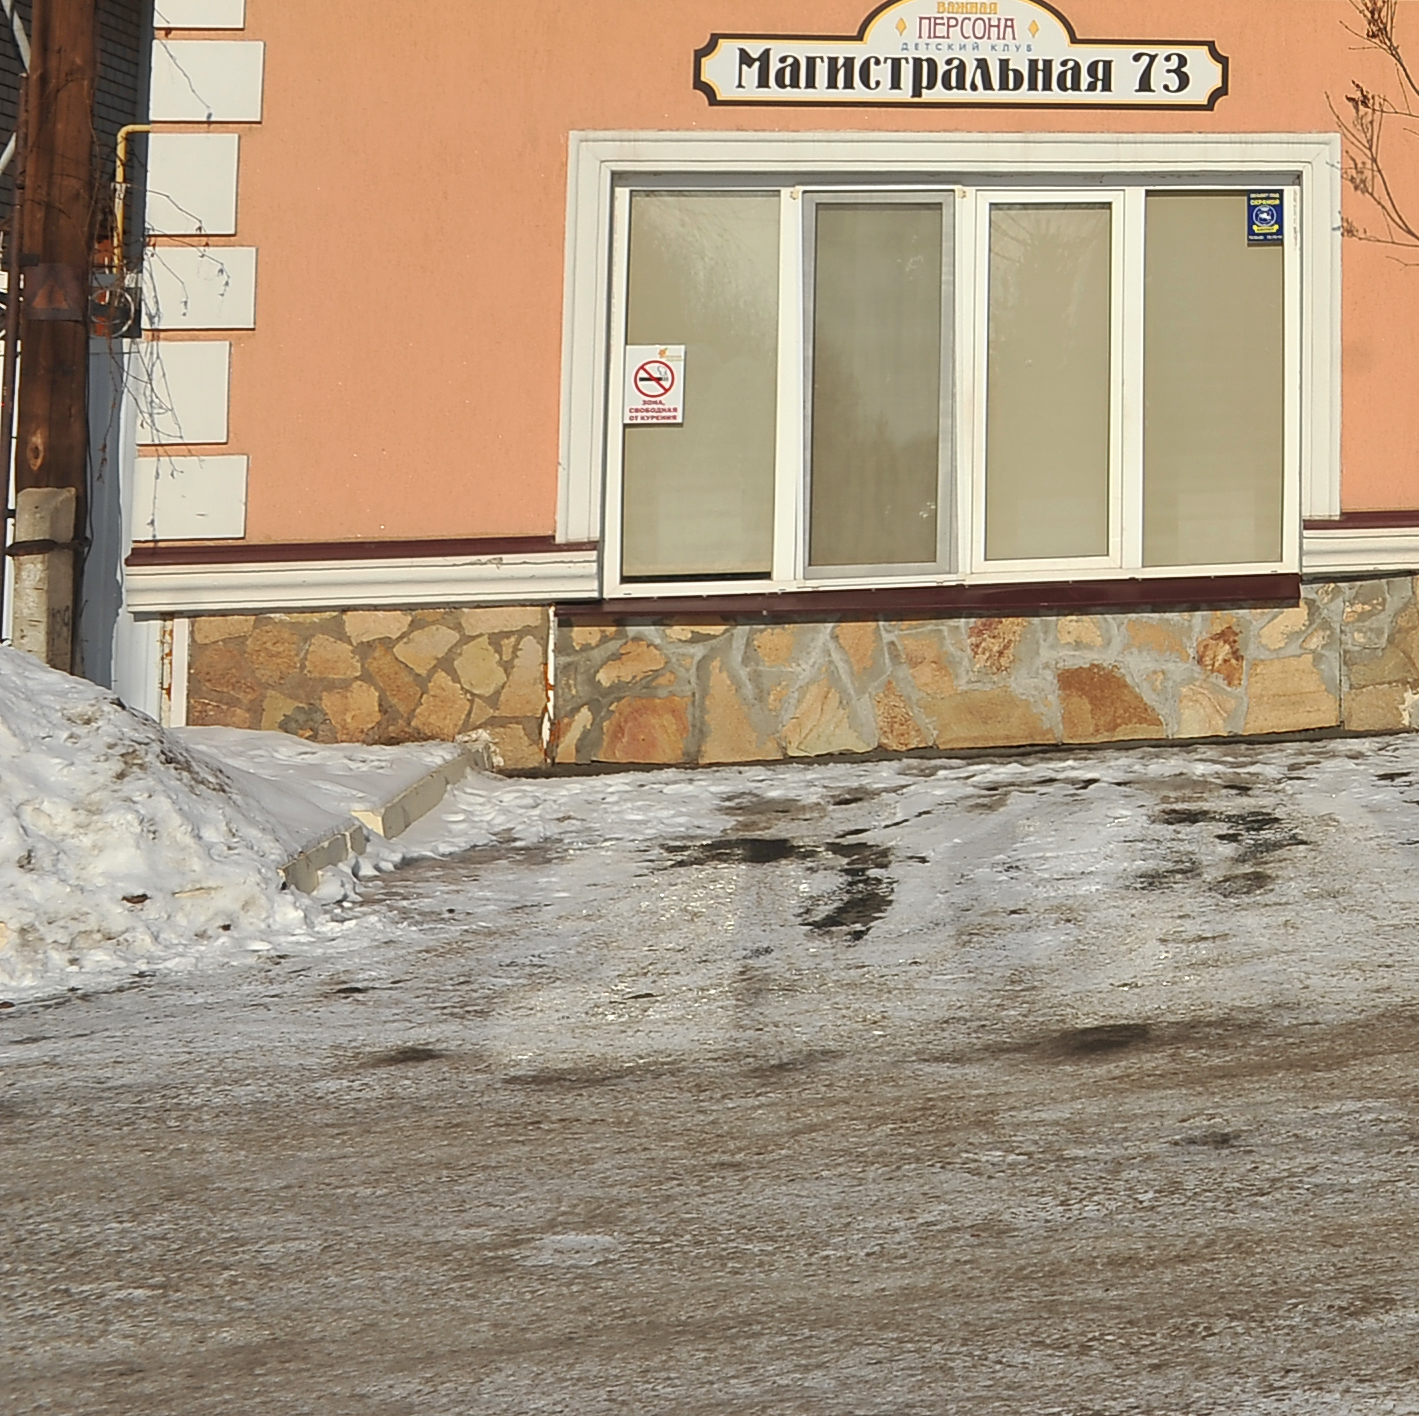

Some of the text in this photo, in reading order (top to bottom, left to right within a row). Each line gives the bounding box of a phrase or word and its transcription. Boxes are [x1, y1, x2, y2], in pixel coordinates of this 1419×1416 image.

[917, 16, 1017, 40] ПЕРСОНА
[901, 41, 1033, 53] ДЕТСКИЙ КЛУБ
[735, 47, 1191, 98] Магистральная 73
